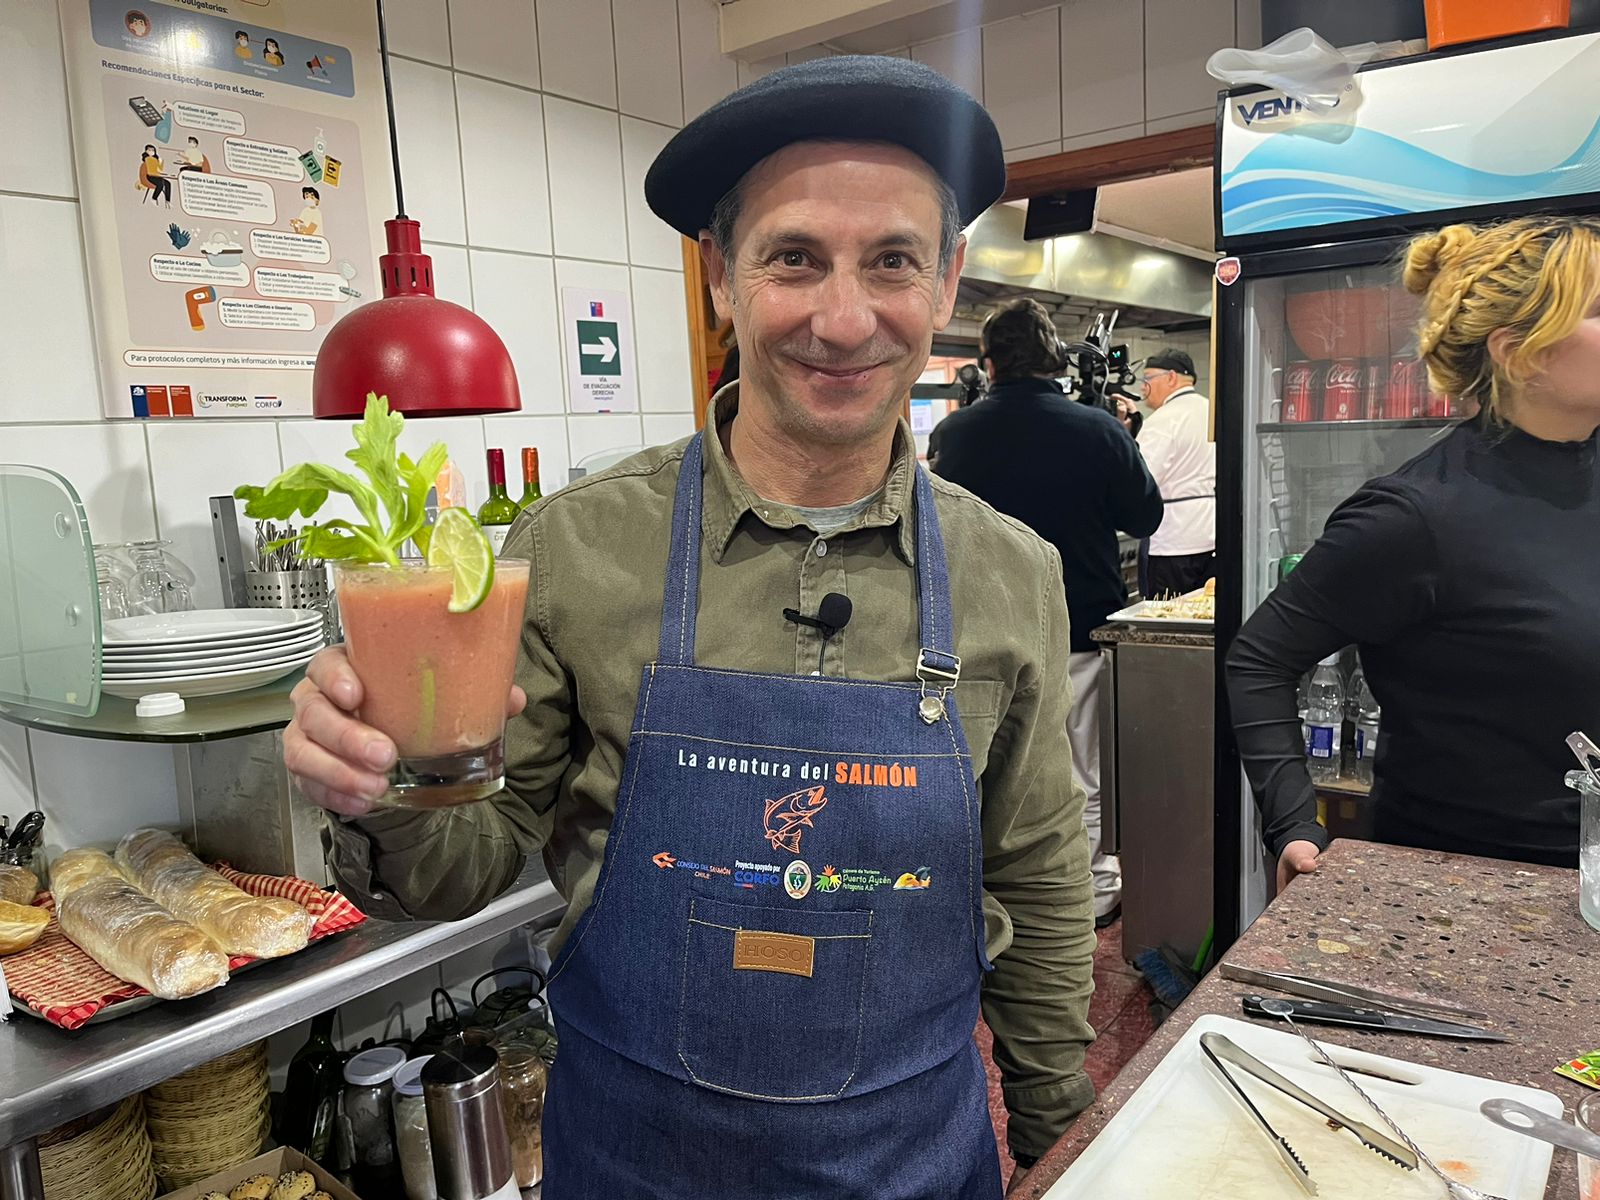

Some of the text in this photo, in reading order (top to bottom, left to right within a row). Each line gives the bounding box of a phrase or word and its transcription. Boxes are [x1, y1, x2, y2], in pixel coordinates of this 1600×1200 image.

[101, 60, 171, 79] Recomendaciones
[214, 83, 231, 92] para
[240, 87, 265, 98] Sector:
[130, 354, 147, 363] Para
[148, 355, 185, 364] protocolos
[186, 356, 220, 365] completos
[226, 357, 240, 365] más
[241, 357, 278, 366] información
[278, 358, 300, 367] ingresa
[255, 401, 281, 409] CORFO
[678, 749, 918, 787] La aventura del SALMÓN
[676, 860, 700, 870] CONSEJO
[709, 865, 732, 876] SALMÓN
[734, 860, 781, 873] Proyecto apoyado por
[694, 871, 710, 880] CHILE
[734, 870, 780, 886] CORFO
[843, 874, 866, 883] Puerto
[743, 944, 804, 963] HOSO
